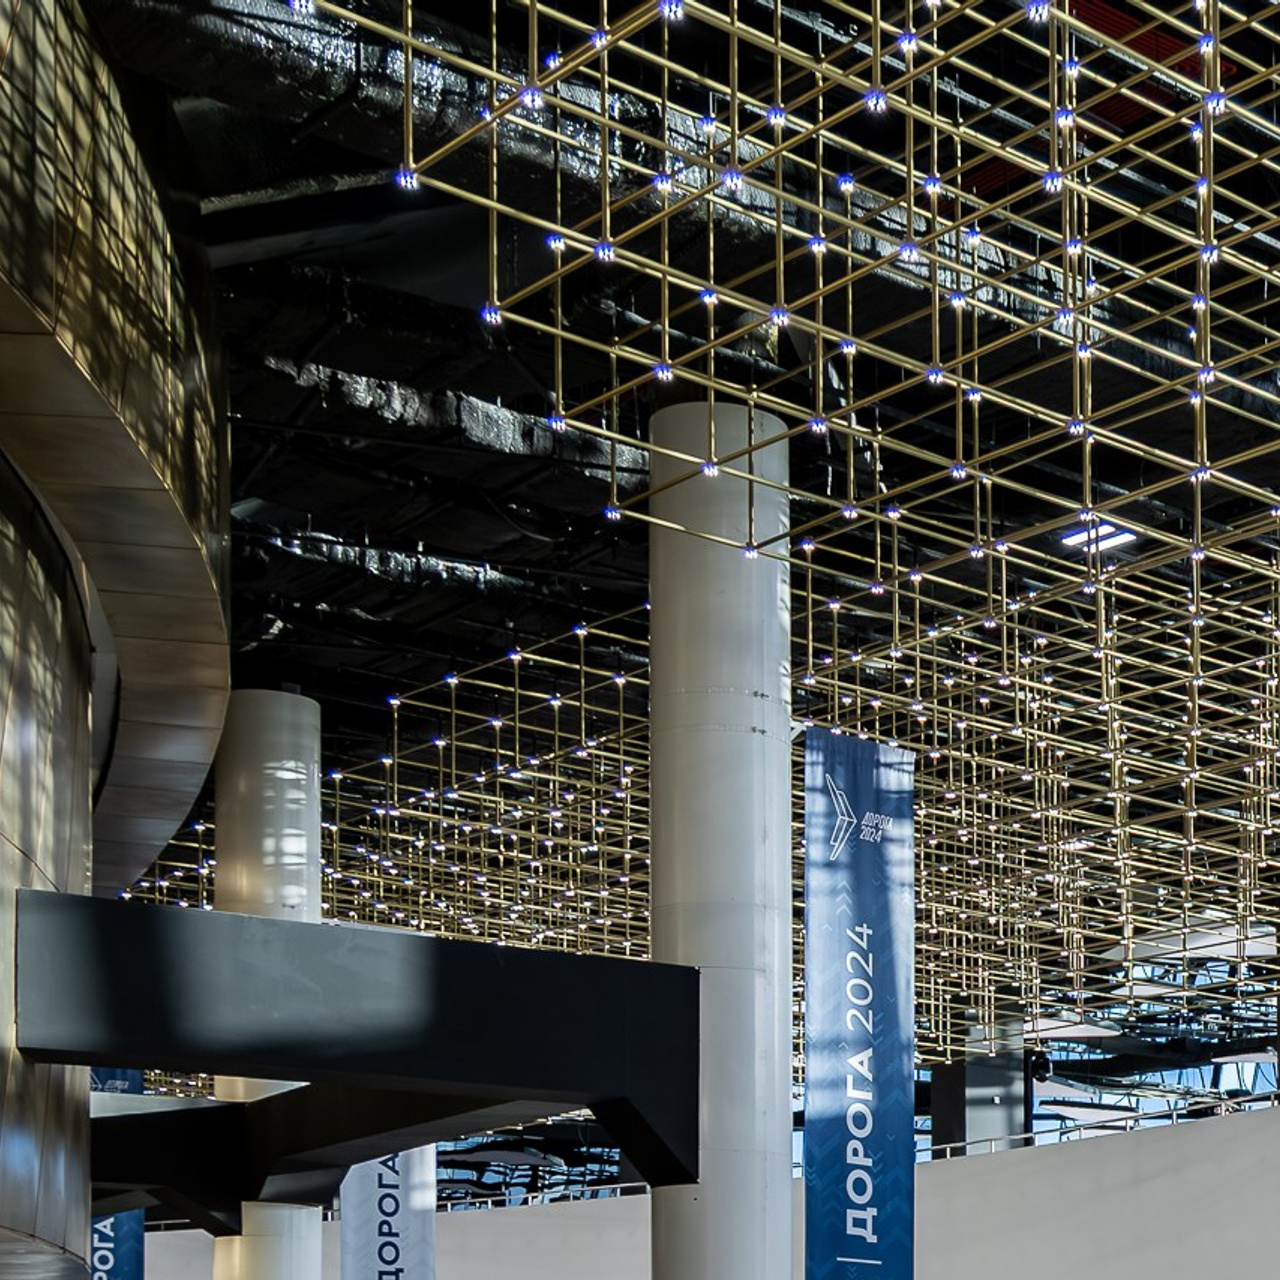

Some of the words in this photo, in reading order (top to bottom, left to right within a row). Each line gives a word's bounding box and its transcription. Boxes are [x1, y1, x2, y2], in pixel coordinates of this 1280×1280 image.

[860, 826, 883, 843] 2024
[846, 923, 873, 1034] 2024
[846, 1047, 877, 1243] ДОРОГА
